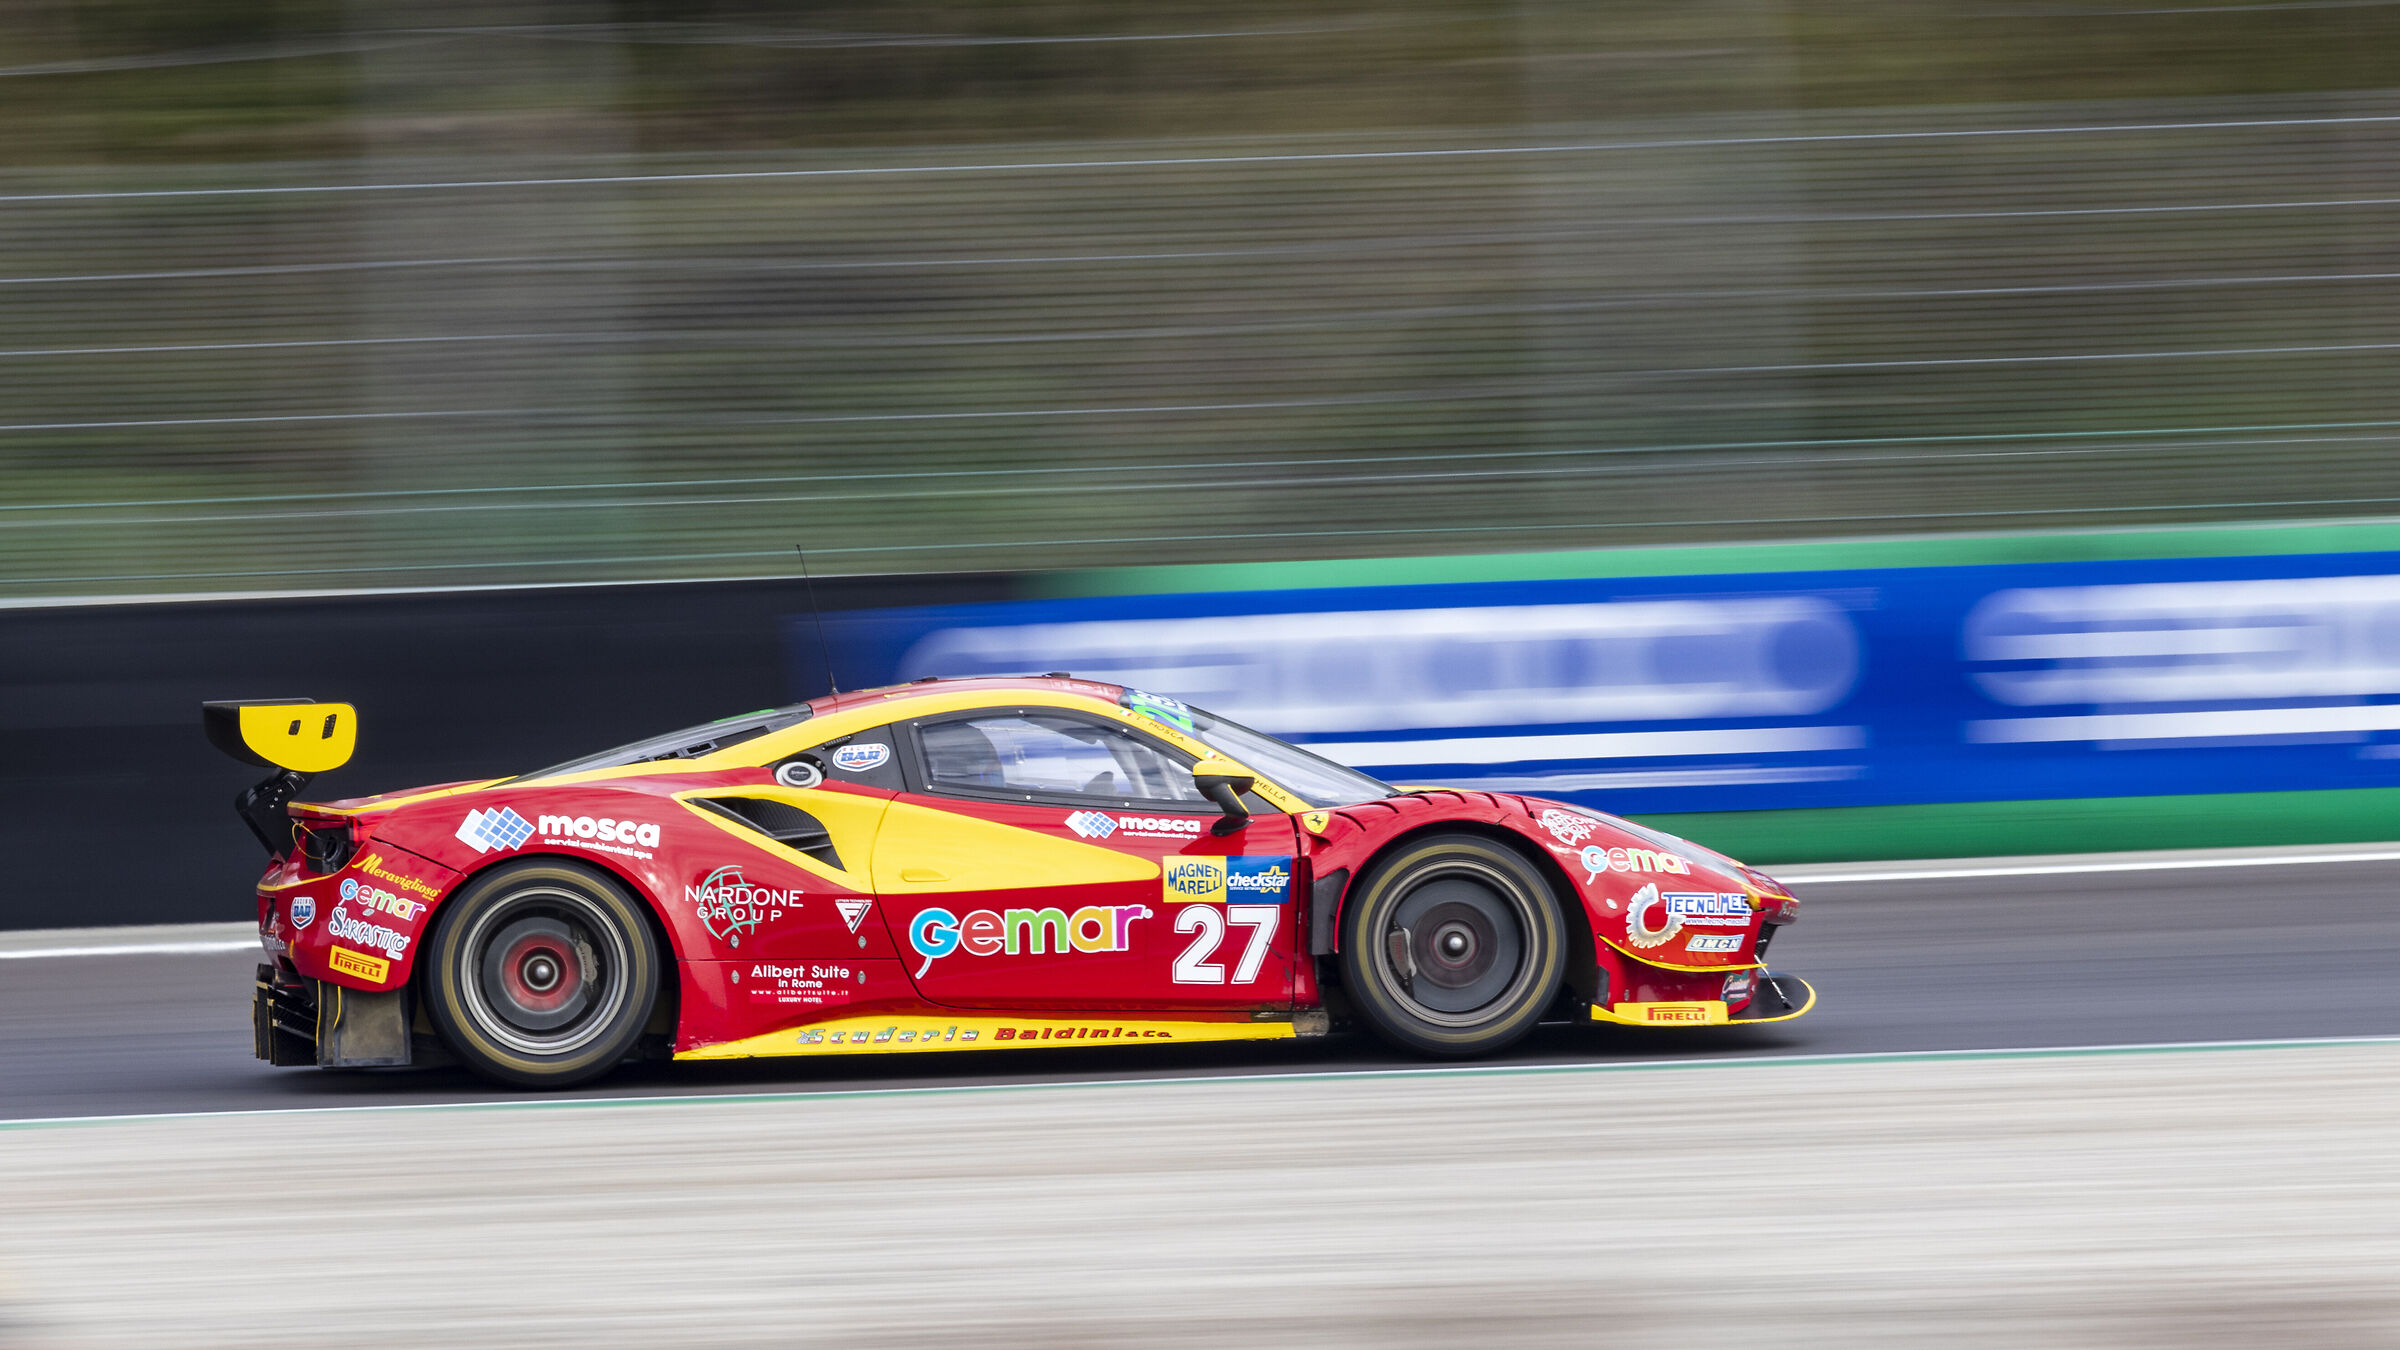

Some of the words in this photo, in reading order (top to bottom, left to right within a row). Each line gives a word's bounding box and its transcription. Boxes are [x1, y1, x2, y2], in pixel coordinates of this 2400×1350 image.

[1149, 722, 1185, 742] MOSCA
[841, 751, 880, 762] BAR
[538, 815, 660, 848] mosca
[1119, 816, 1201, 833] mosca
[351, 853, 439, 897] Meraviglioso
[1227, 872, 1289, 887] checkstar
[338, 878, 427, 922] Gemar
[685, 885, 804, 907] NARDONE
[293, 905, 311, 917] BAR
[696, 906, 783, 922] GROUP
[909, 904, 1150, 979] Gemar
[1172, 904, 1280, 984] 27
[334, 952, 382, 978] PIRELLI
[751, 965, 805, 978] Alibert
[811, 966, 850, 979] Suite
[791, 979, 823, 988] Rome
[1647, 1007, 1705, 1021] PIRELLI
[806, 1026, 979, 1044] Scuderia
[995, 1027, 1122, 1040] Baldini
